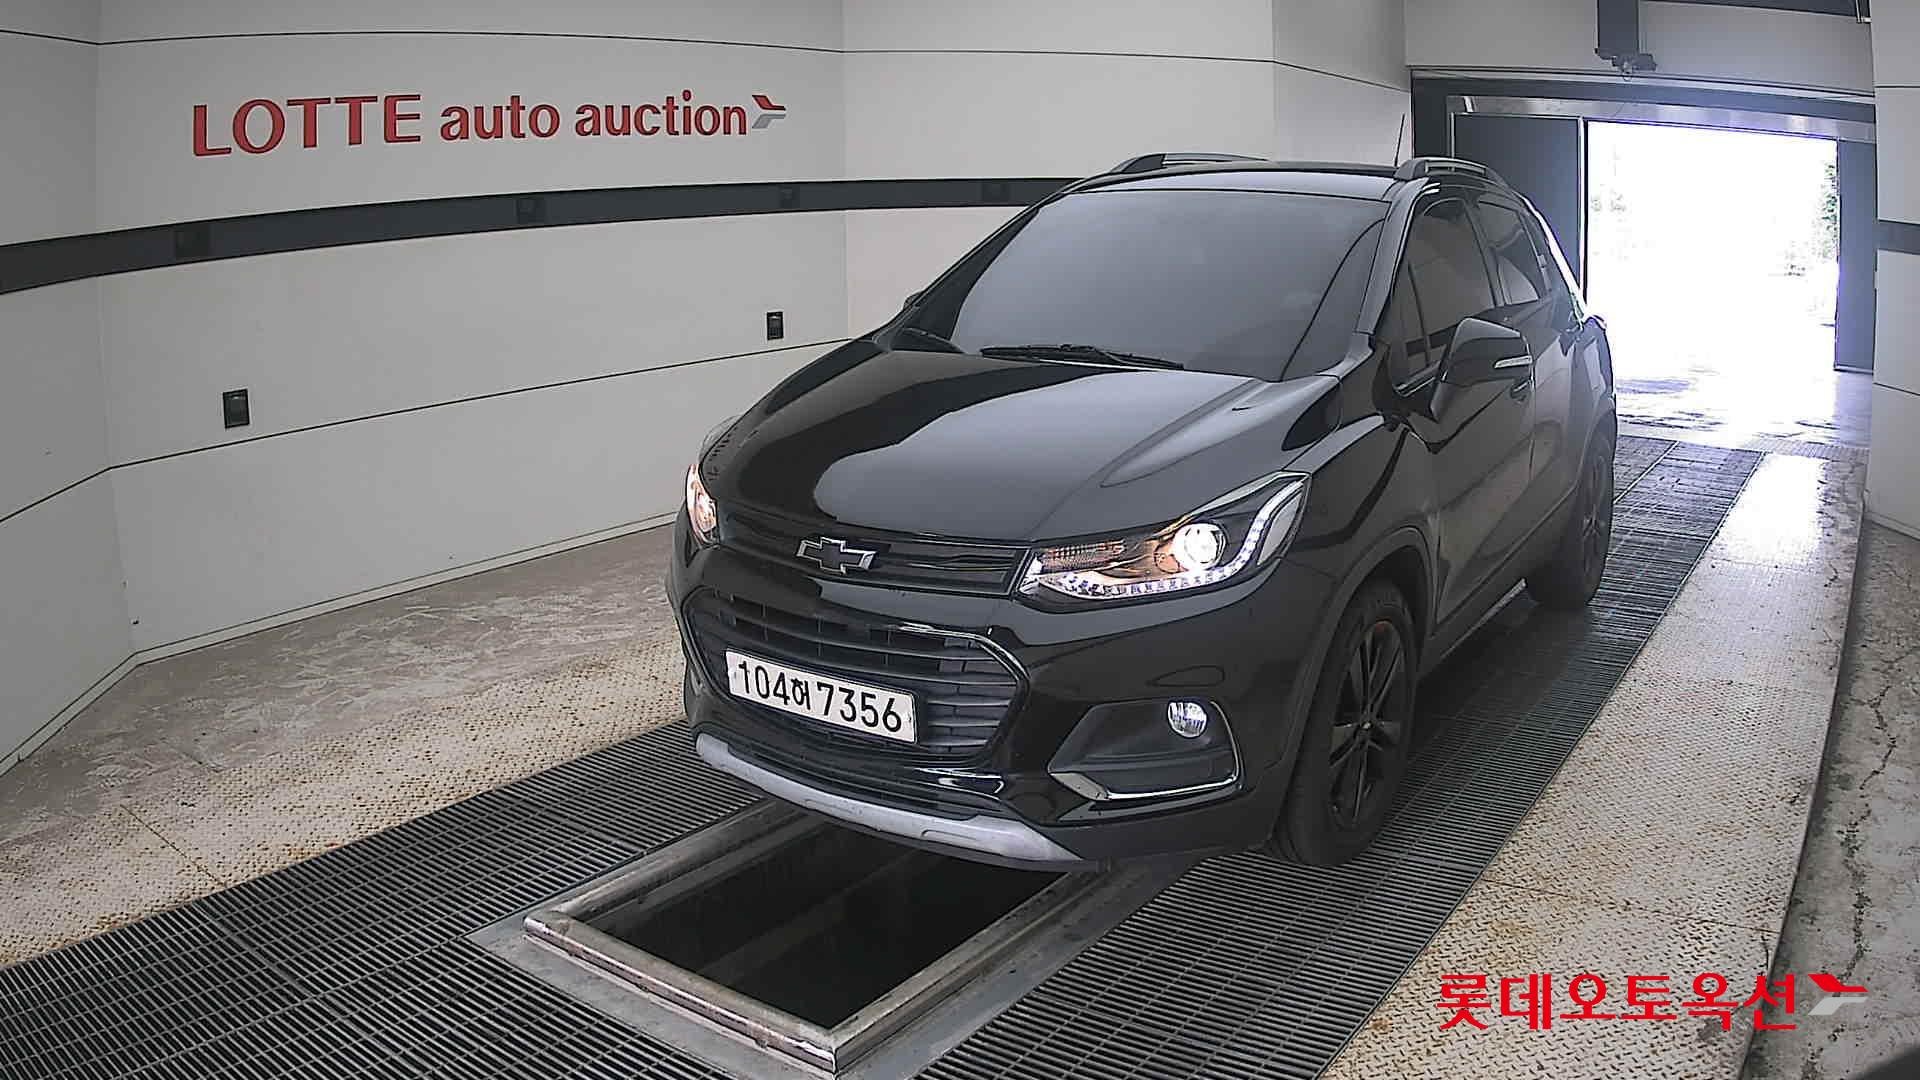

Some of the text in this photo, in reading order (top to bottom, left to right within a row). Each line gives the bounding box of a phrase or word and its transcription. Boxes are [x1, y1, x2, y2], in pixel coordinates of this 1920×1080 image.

[193, 90, 748, 156] LOTTE auto auction
